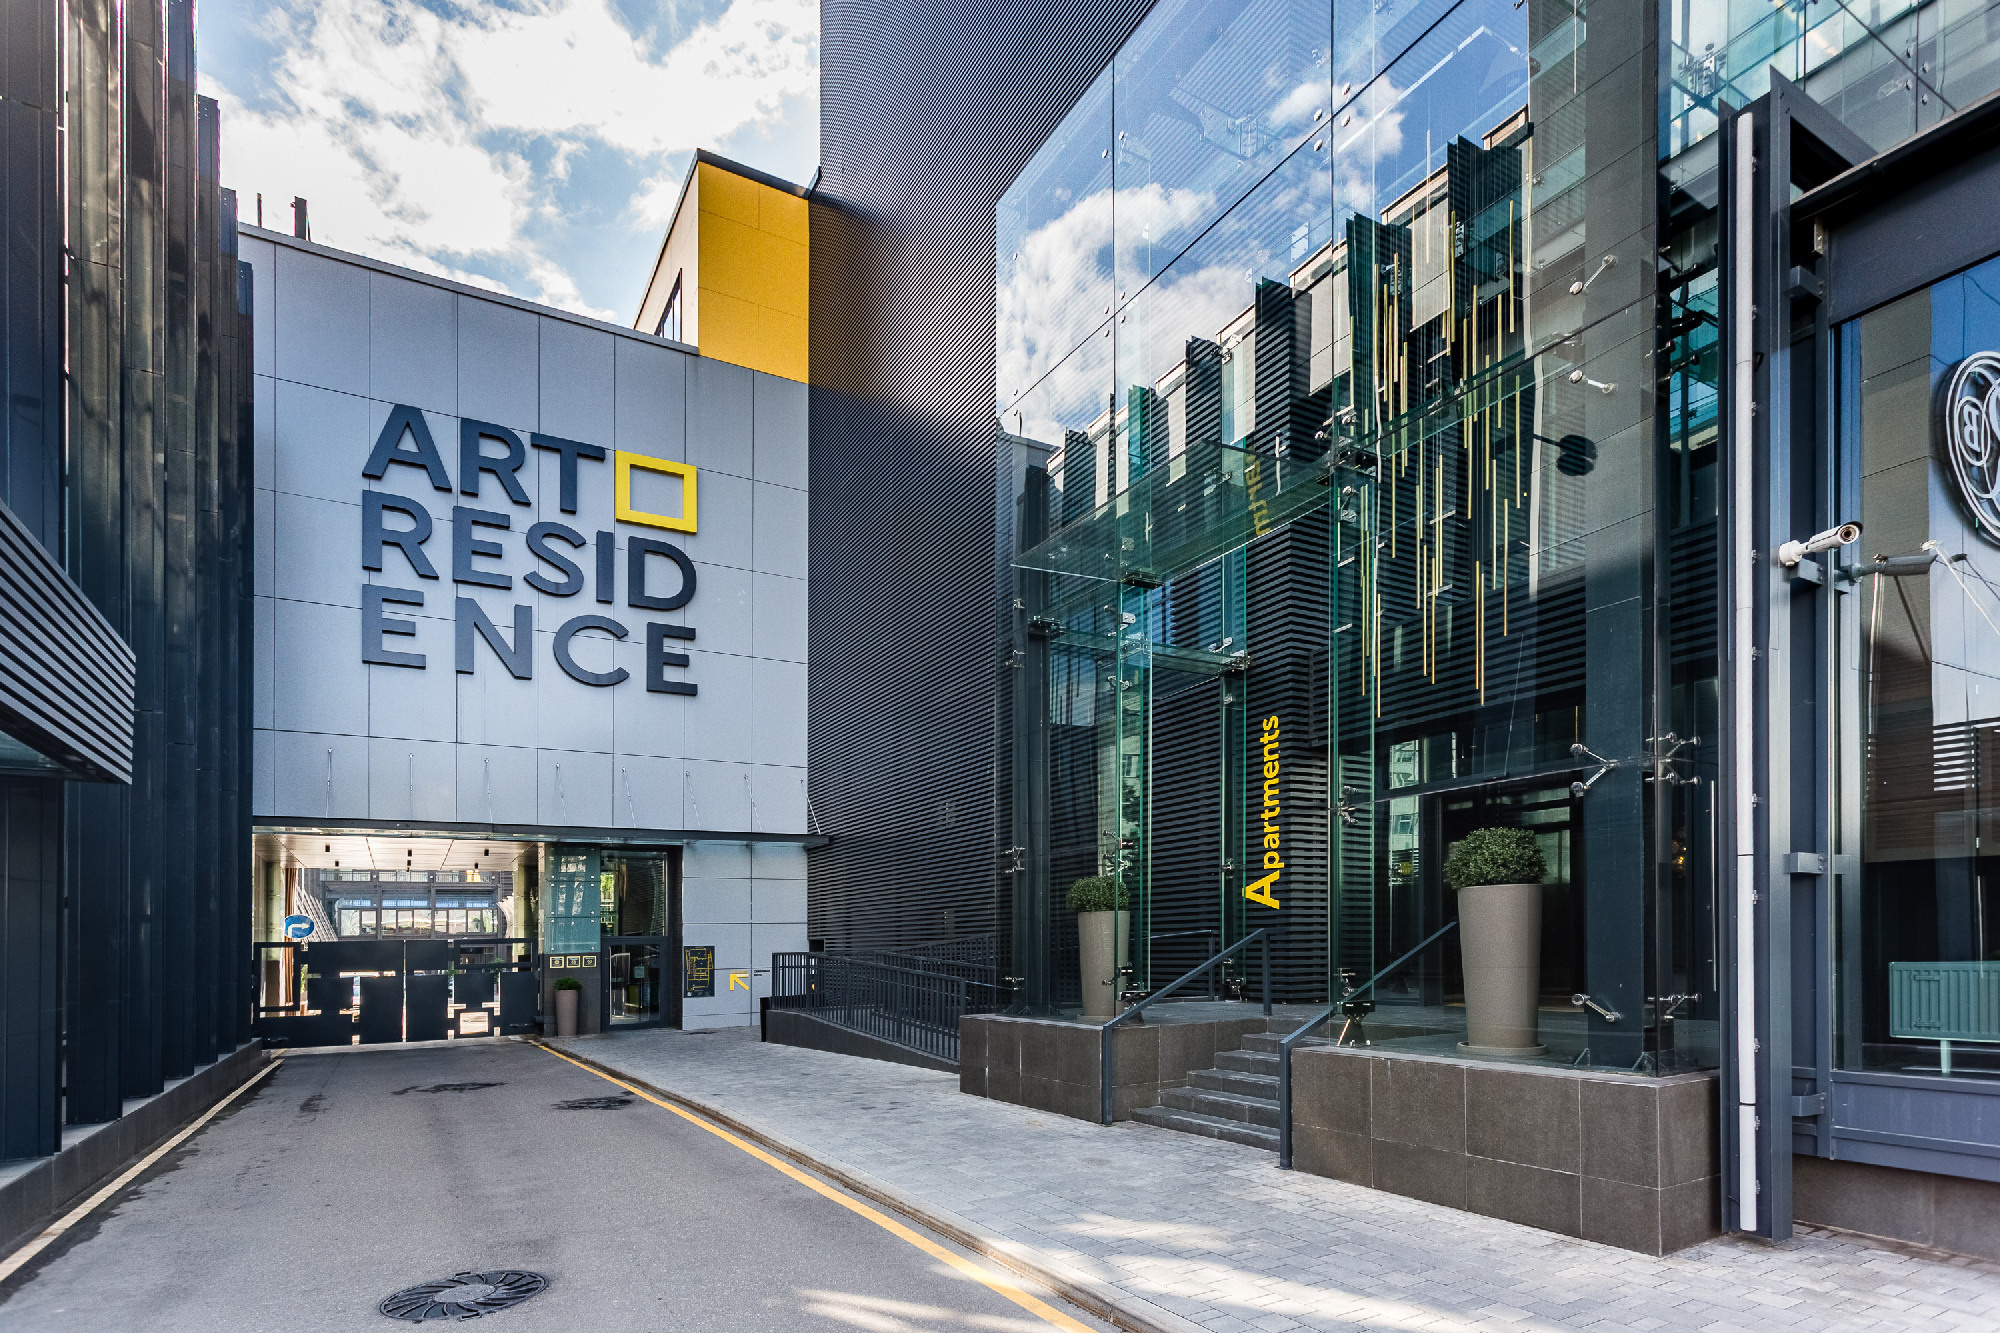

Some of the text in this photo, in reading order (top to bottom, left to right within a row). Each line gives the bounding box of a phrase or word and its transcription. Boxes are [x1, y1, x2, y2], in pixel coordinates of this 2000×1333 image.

[362, 403, 606, 514] ART
[362, 489, 697, 612] RESID
[362, 584, 698, 696] ENCE
[1242, 715, 1285, 910] Apartments
